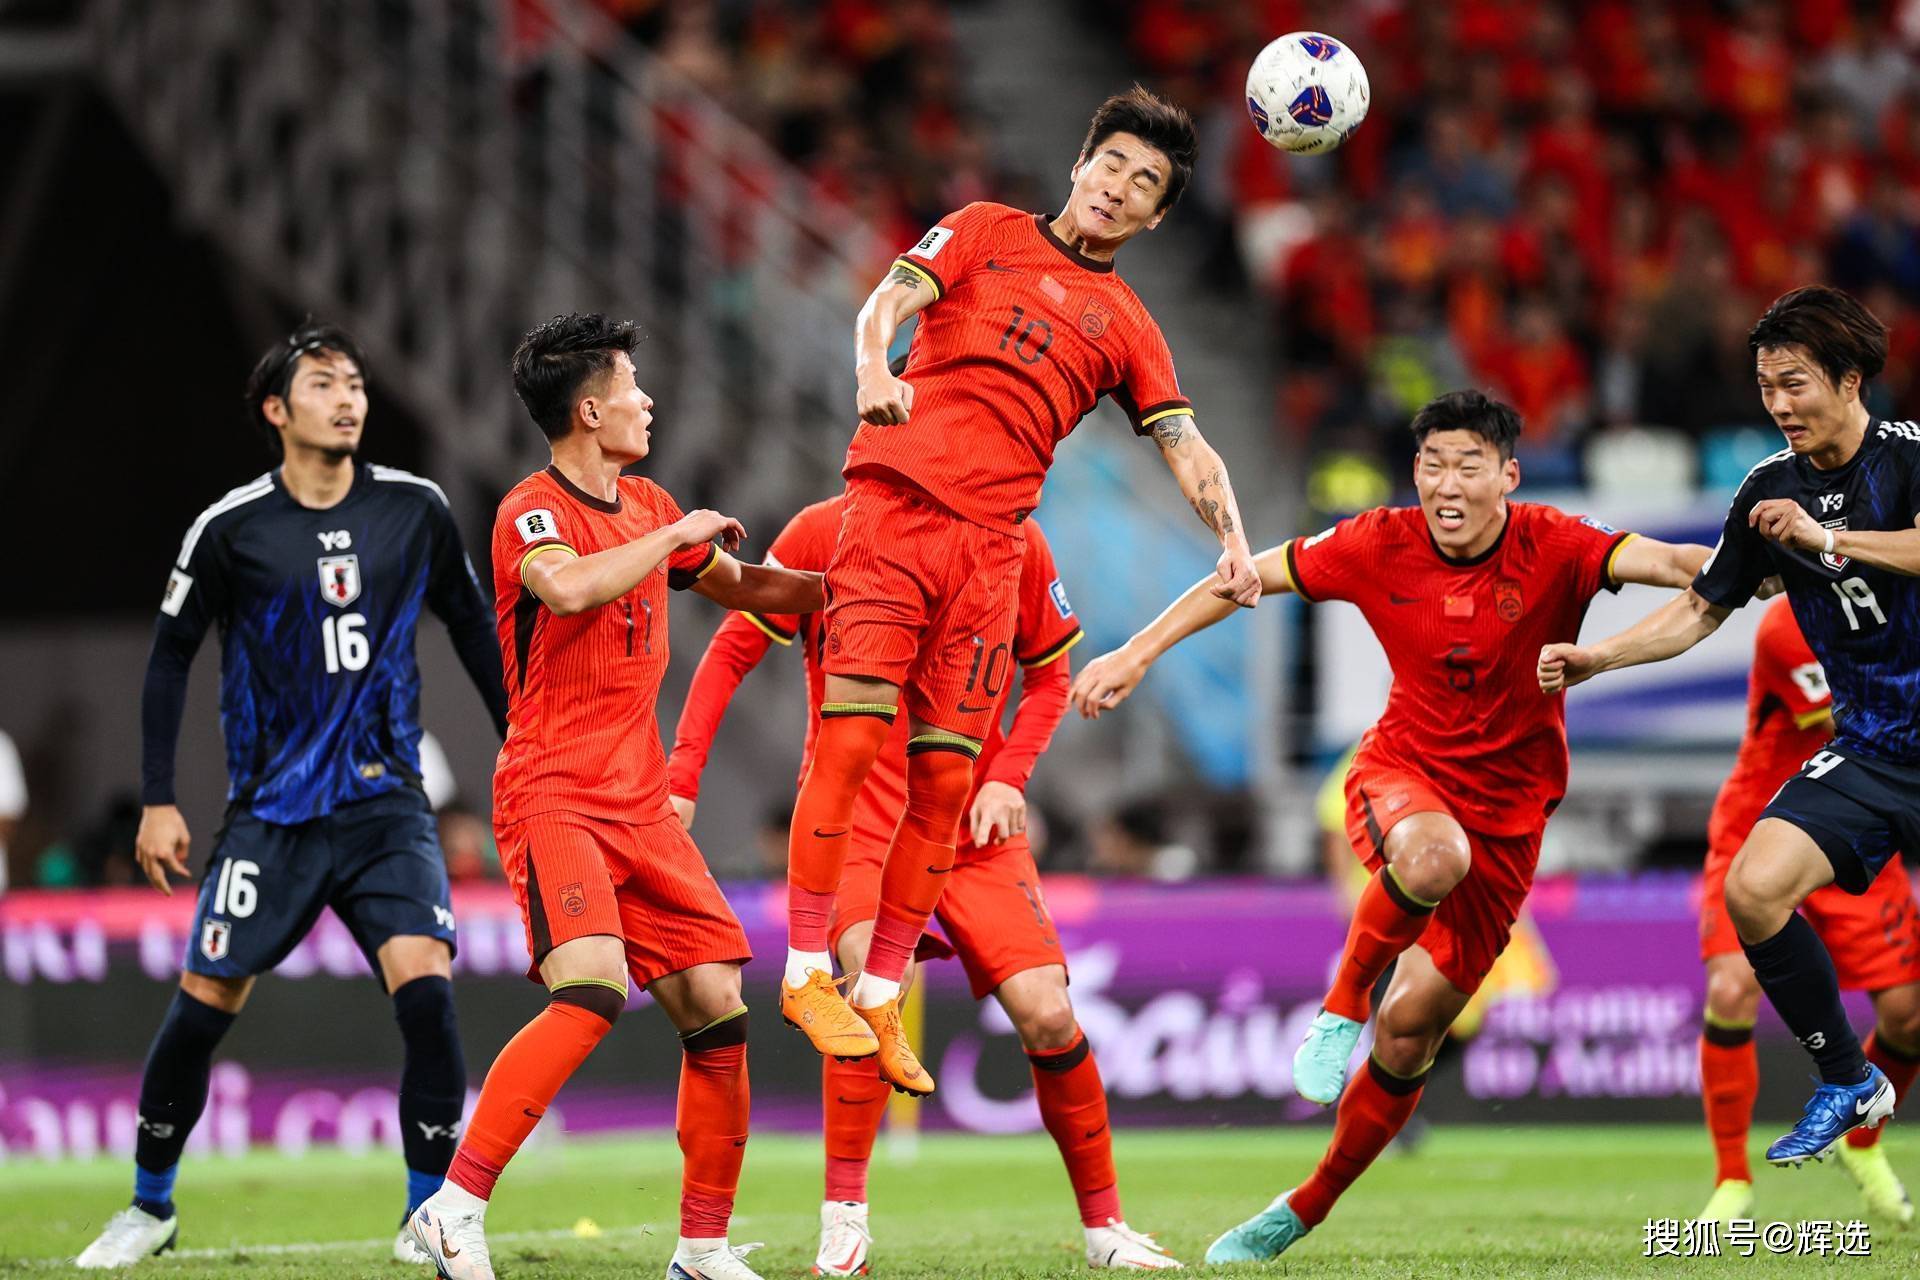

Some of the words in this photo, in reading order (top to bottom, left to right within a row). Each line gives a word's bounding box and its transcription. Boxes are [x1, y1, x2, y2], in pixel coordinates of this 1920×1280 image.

[999, 305, 1053, 364] 10
[1819, 493, 1844, 513] Y-3
[1825, 521, 1843, 529] JAPAN
[623, 599, 652, 657] 11
[1831, 576, 1888, 631] 19
[322, 612, 370, 674] 16
[965, 636, 1009, 697] 10
[1446, 647, 1475, 691] 5
[1801, 750, 1846, 779] 9
[213, 857, 260, 918] 16
